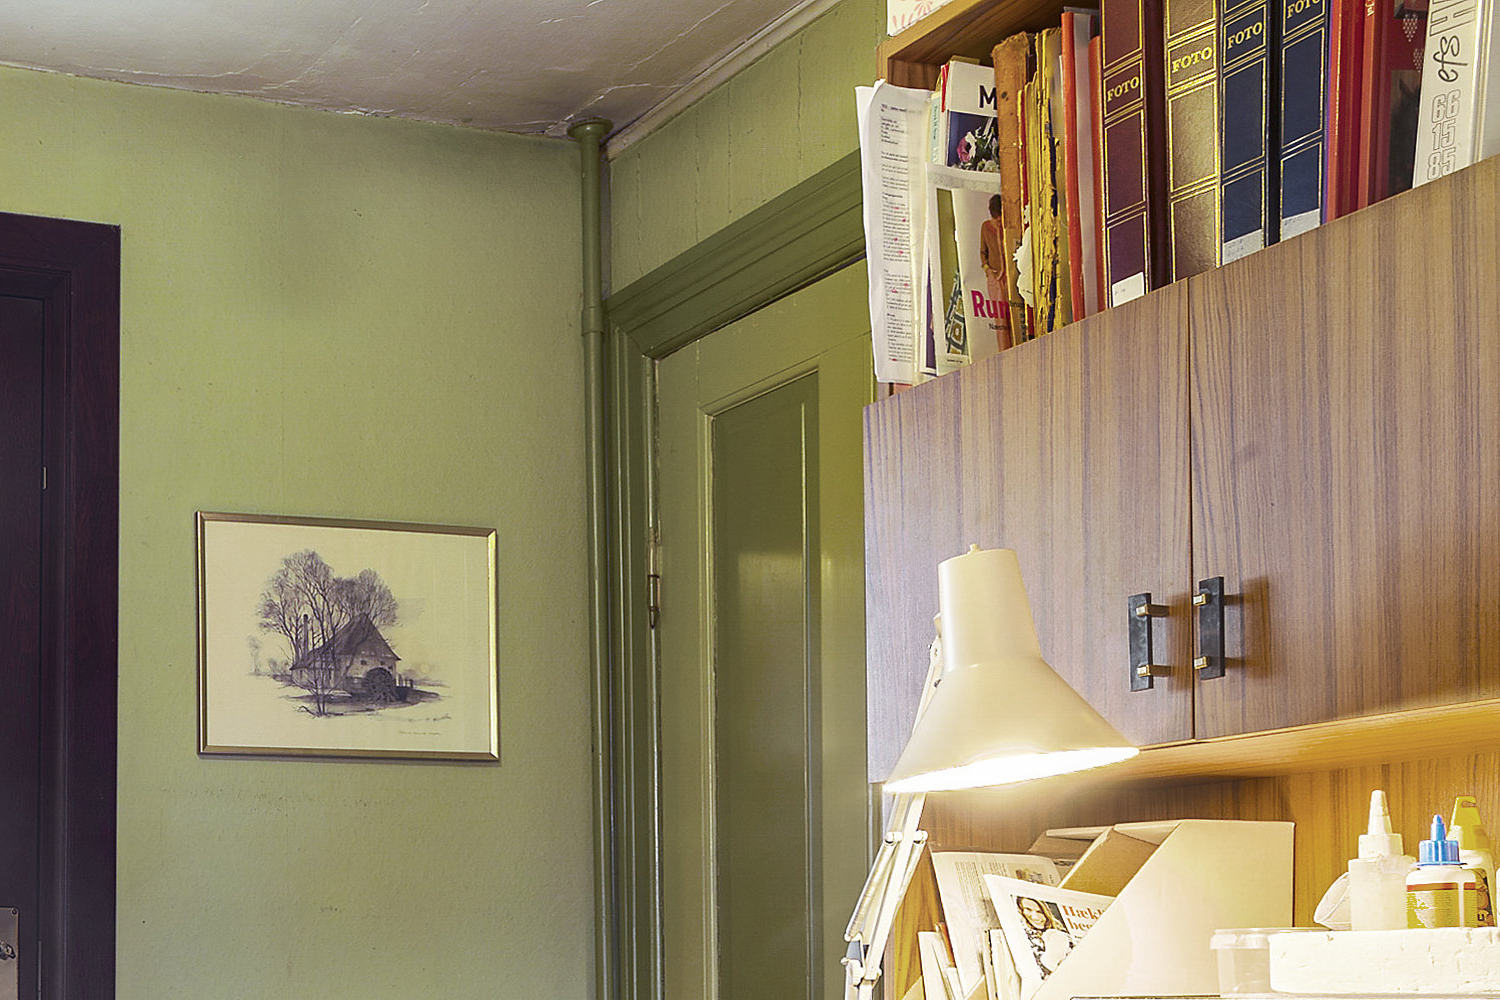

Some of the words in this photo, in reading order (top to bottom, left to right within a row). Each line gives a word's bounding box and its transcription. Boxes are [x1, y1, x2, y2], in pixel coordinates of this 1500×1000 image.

[1226, 21, 1263, 50] FOTO
[1171, 46, 1213, 74] FOTO
[1106, 75, 1140, 103] FOTO
[1431, 89, 1461, 124] 66
